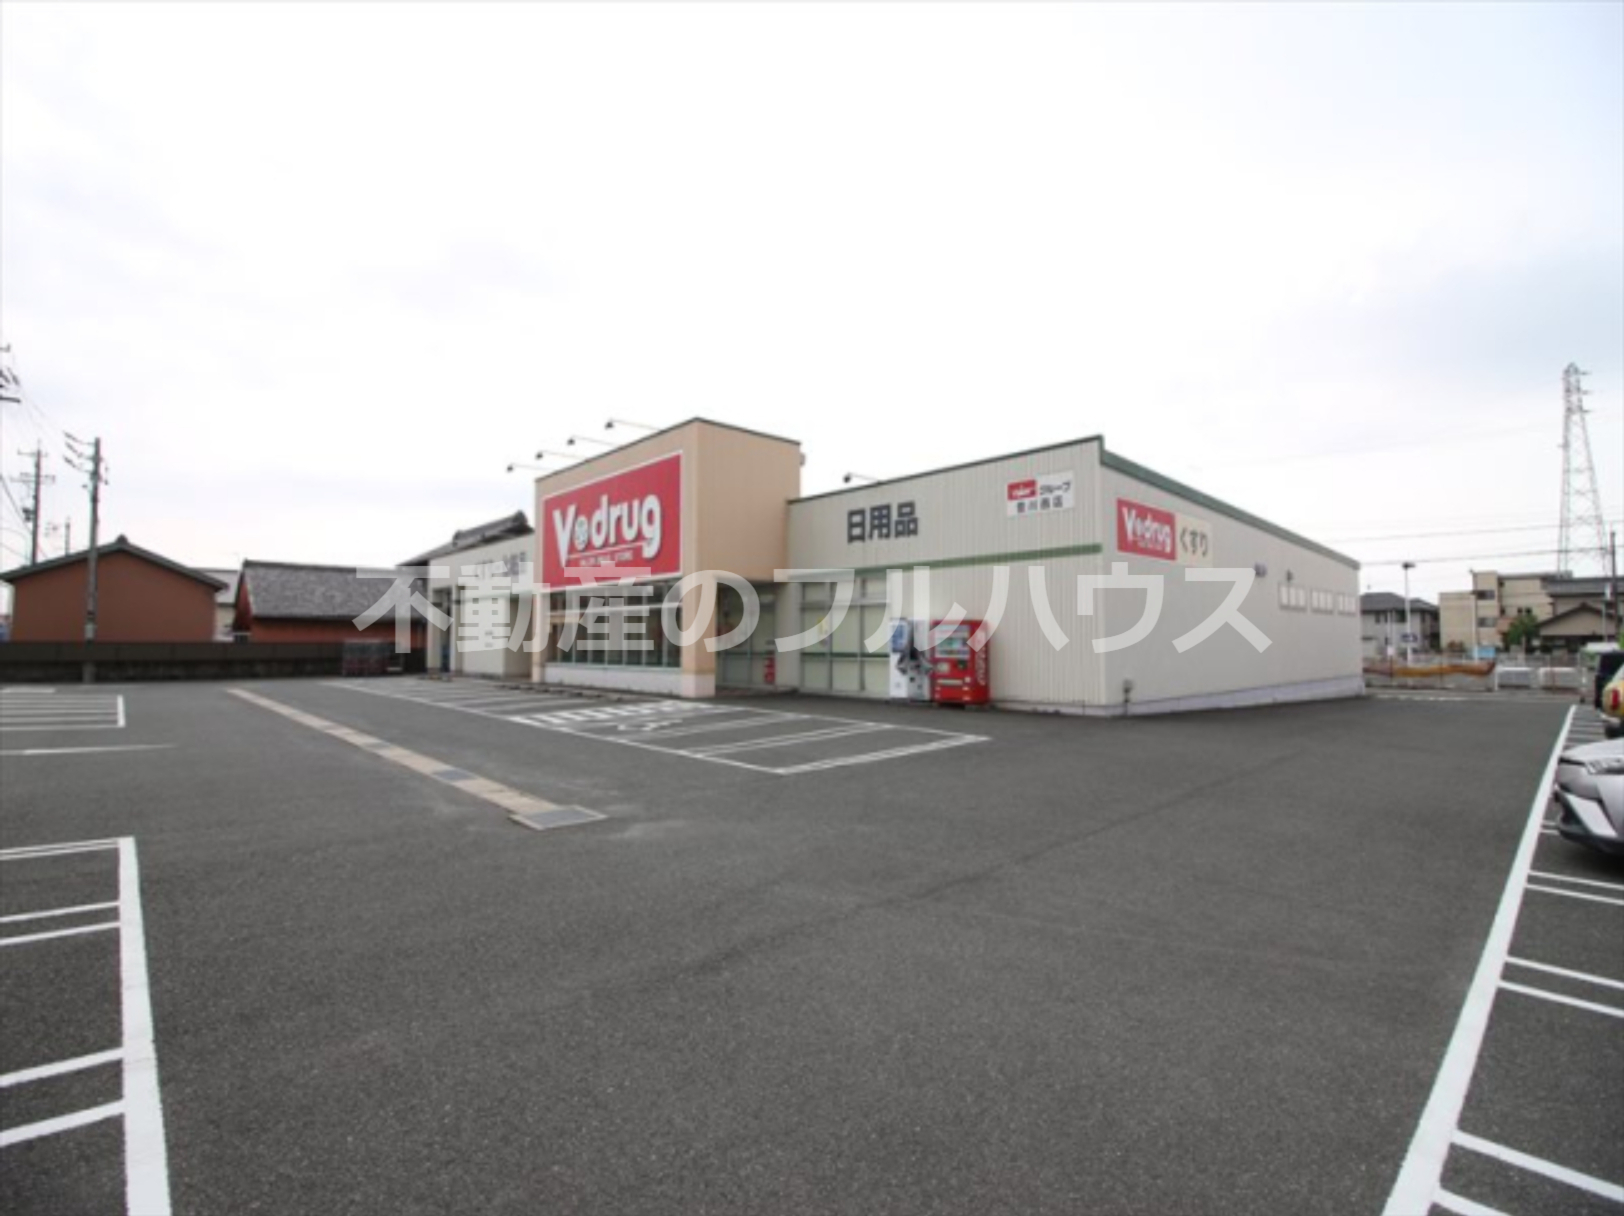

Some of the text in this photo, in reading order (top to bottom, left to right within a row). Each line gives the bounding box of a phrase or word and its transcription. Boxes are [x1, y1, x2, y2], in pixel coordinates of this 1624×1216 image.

[847, 500, 918, 544] 日用品
[1180, 526, 1208, 558] くすり
